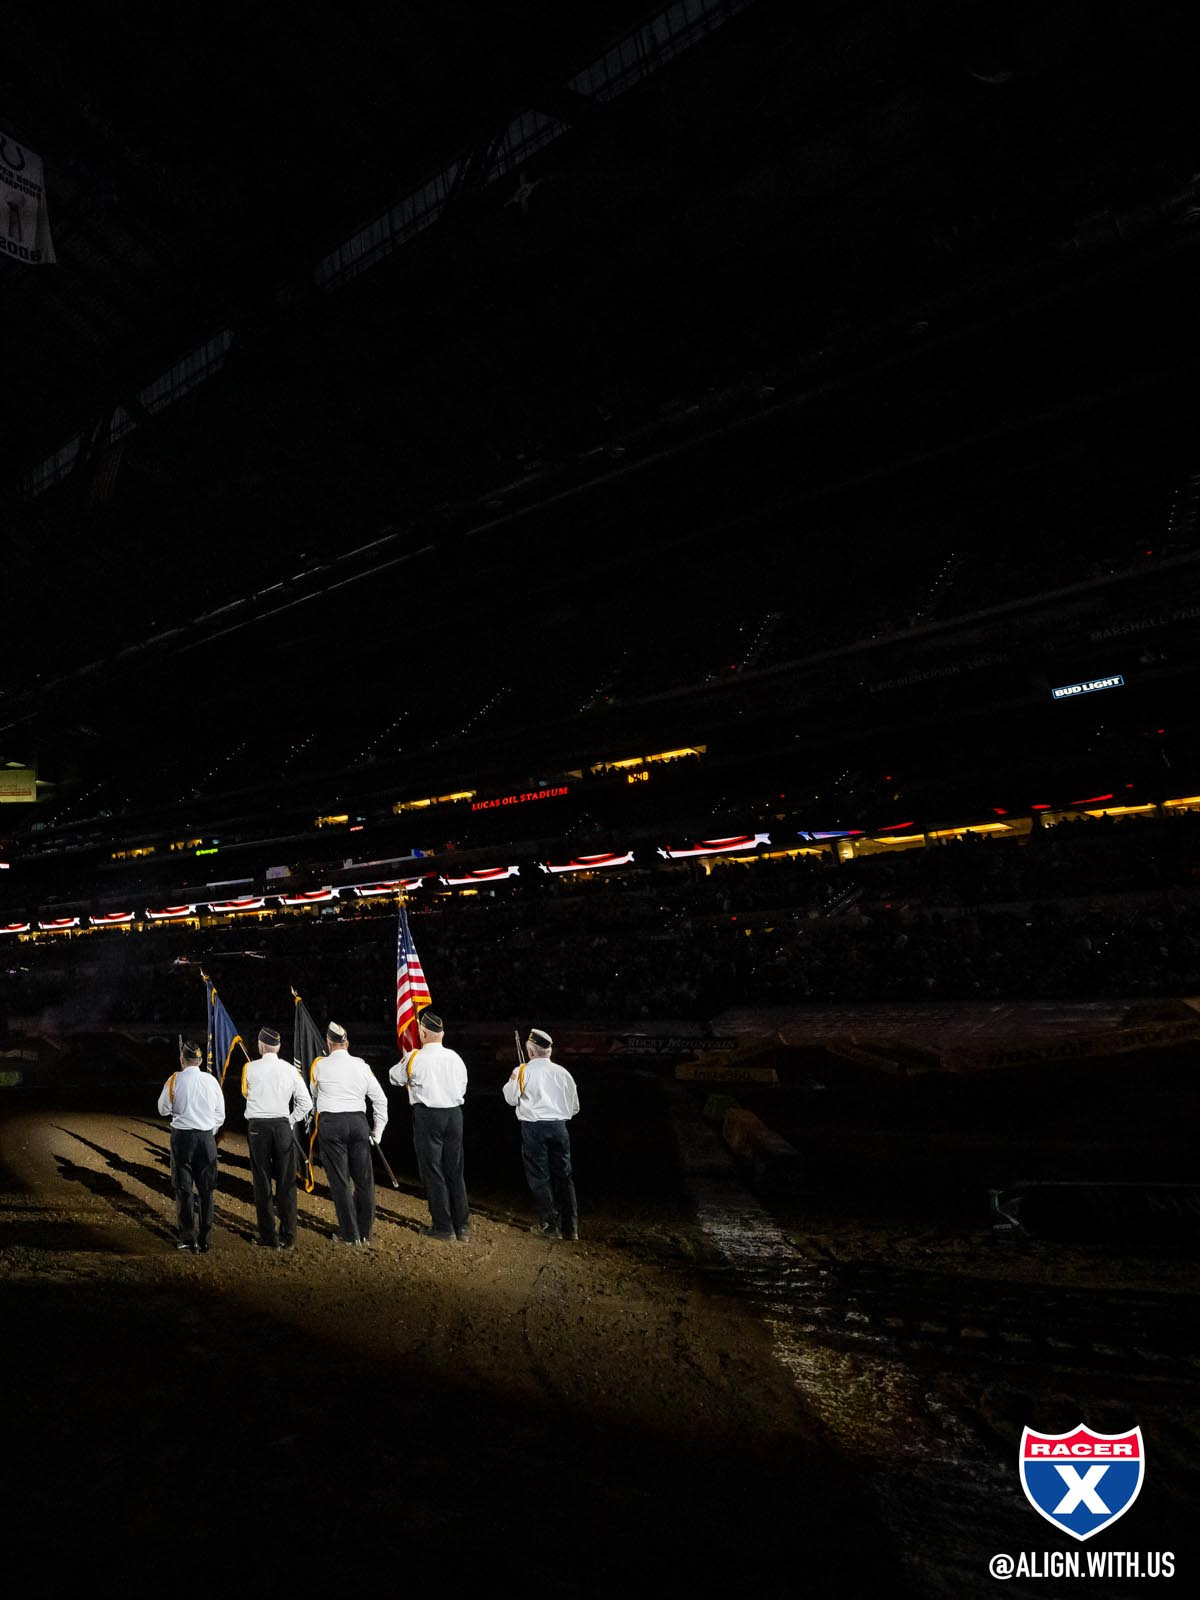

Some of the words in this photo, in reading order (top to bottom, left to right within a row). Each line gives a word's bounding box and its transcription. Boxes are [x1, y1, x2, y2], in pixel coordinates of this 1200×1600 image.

[1054, 686, 1080, 698] BUD
[1080, 676, 1122, 694] LIGHT
[471, 799, 501, 811] LUCAS
[502, 796, 520, 806] OIL
[519, 786, 569, 803] STADIUM
